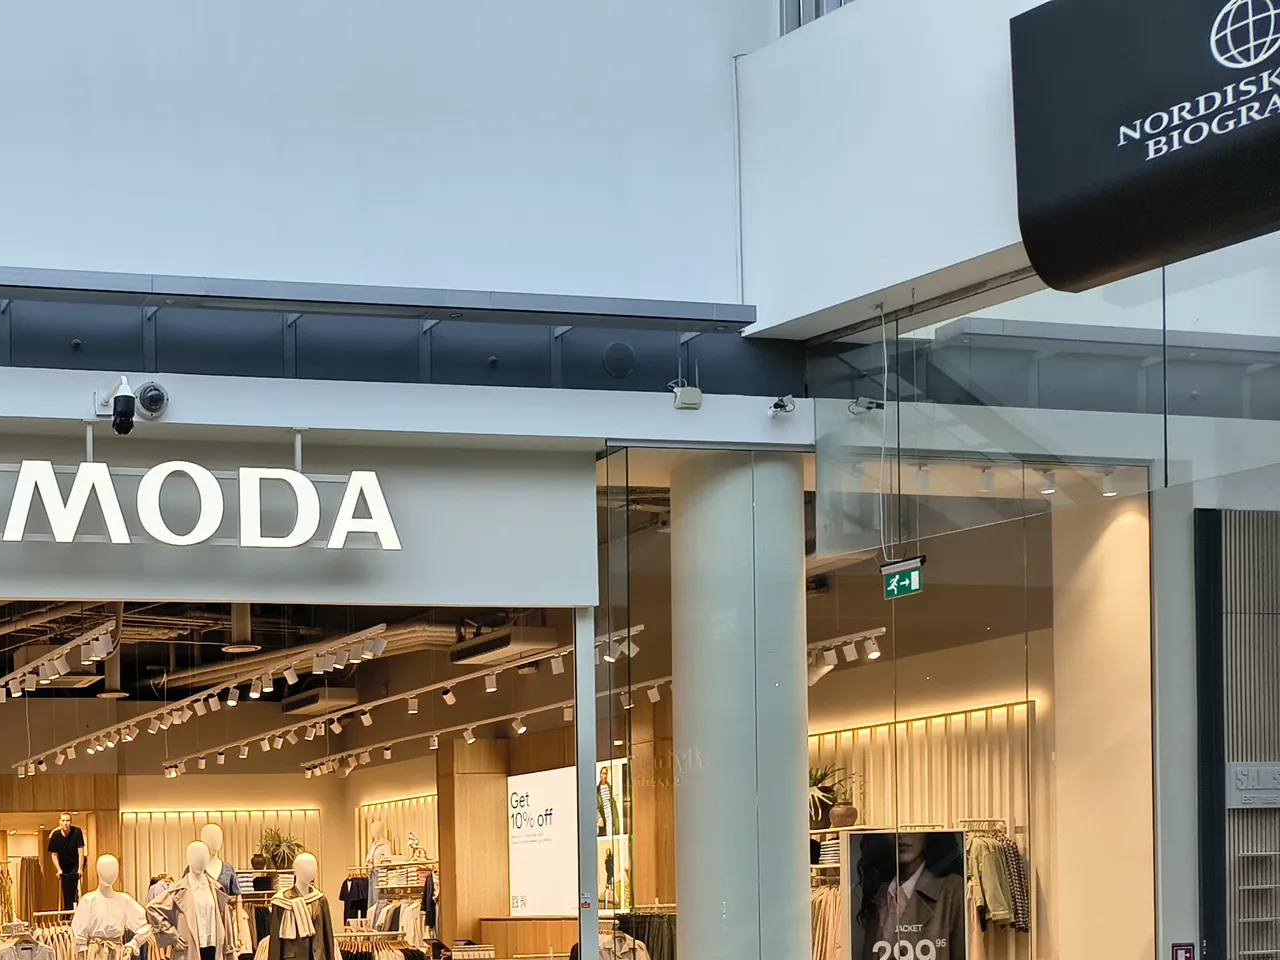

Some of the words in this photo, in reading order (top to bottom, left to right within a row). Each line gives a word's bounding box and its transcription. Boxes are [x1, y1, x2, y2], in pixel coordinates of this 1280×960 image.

[1117, 66, 1280, 147] NORDISK
[2, 458, 402, 551] MODA
[510, 792, 529, 809] Get
[510, 811, 534, 829] 10%
[537, 808, 553, 827] off
[894, 924, 923, 933] JACKET
[935, 938, 947, 948] 95
